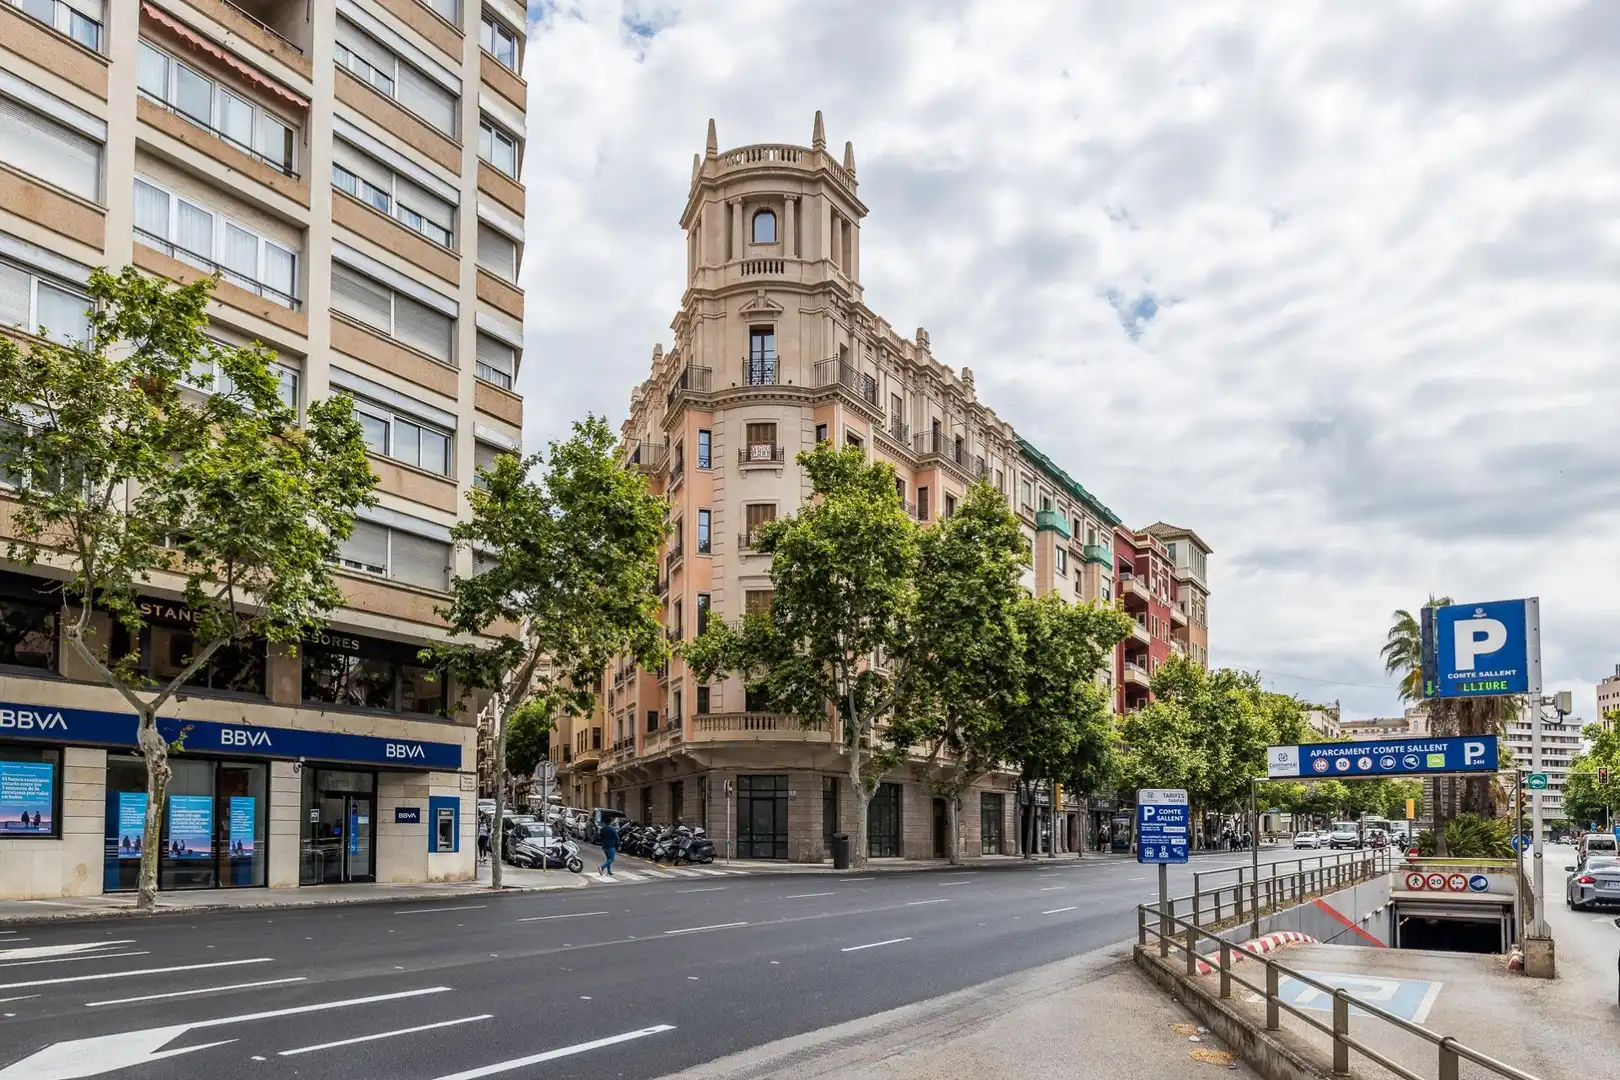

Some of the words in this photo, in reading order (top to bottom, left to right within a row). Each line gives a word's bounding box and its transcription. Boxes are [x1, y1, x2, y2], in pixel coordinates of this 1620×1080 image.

[302, 632, 360, 650] ESORES
[1454, 618, 1507, 670] P
[1464, 680, 1507, 691] LLIURE
[0, 709, 68, 730] BBVA
[221, 729, 272, 746] BBVA
[386, 744, 425, 758] BBVA
[1310, 748, 1370, 757] APARCAMENT
[1373, 746, 1405, 754] COMTE
[1407, 744, 1448, 752] SALLENT
[1464, 742, 1485, 765] P
[1144, 806, 1155, 821] P
